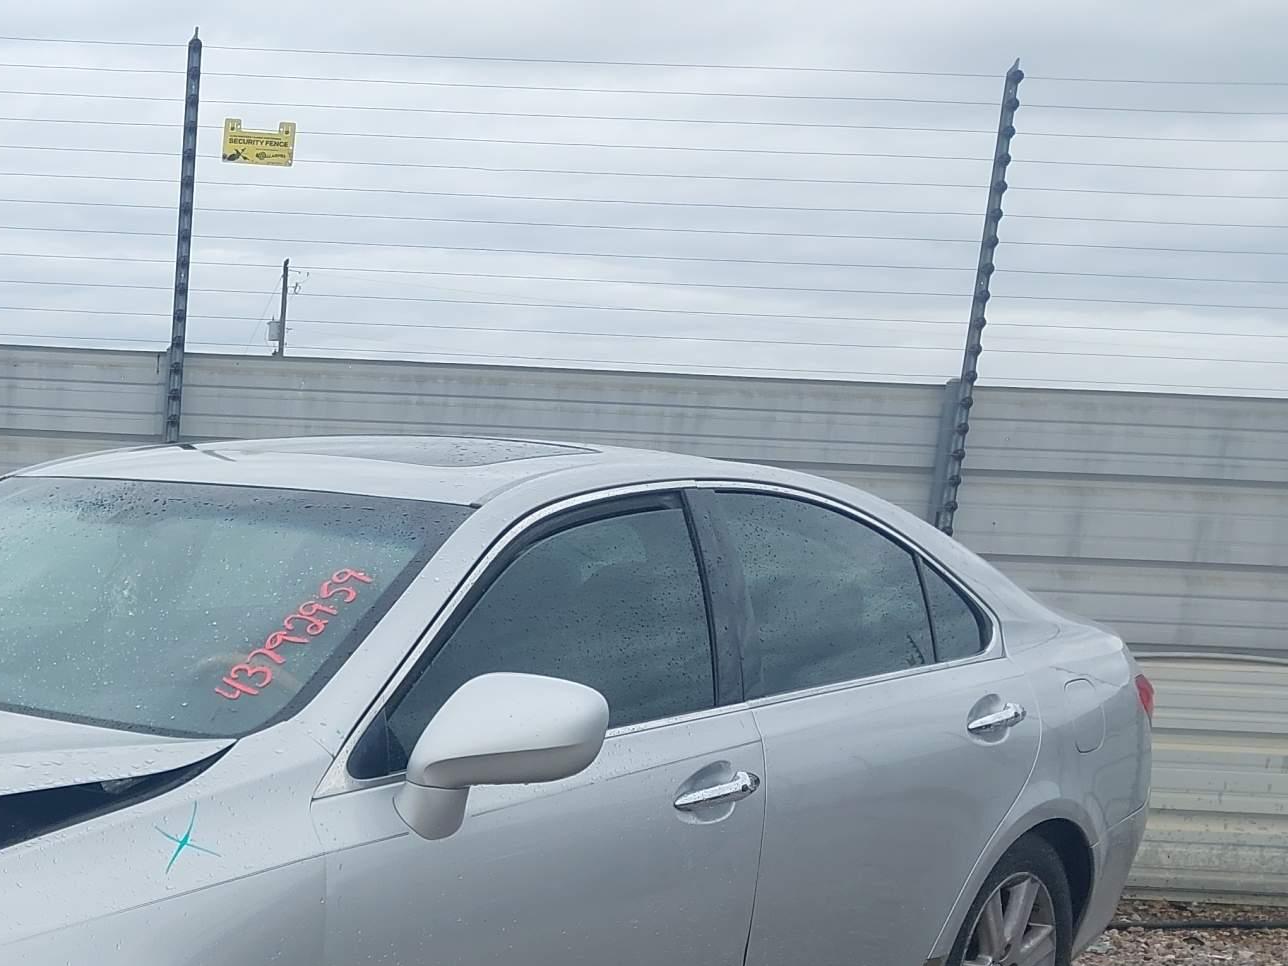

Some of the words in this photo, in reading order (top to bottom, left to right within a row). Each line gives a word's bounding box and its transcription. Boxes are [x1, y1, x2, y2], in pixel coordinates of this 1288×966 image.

[229, 138, 264, 146] SECURITY
[265, 140, 289, 148] FENCE
[215, 568, 373, 700] 43792959
